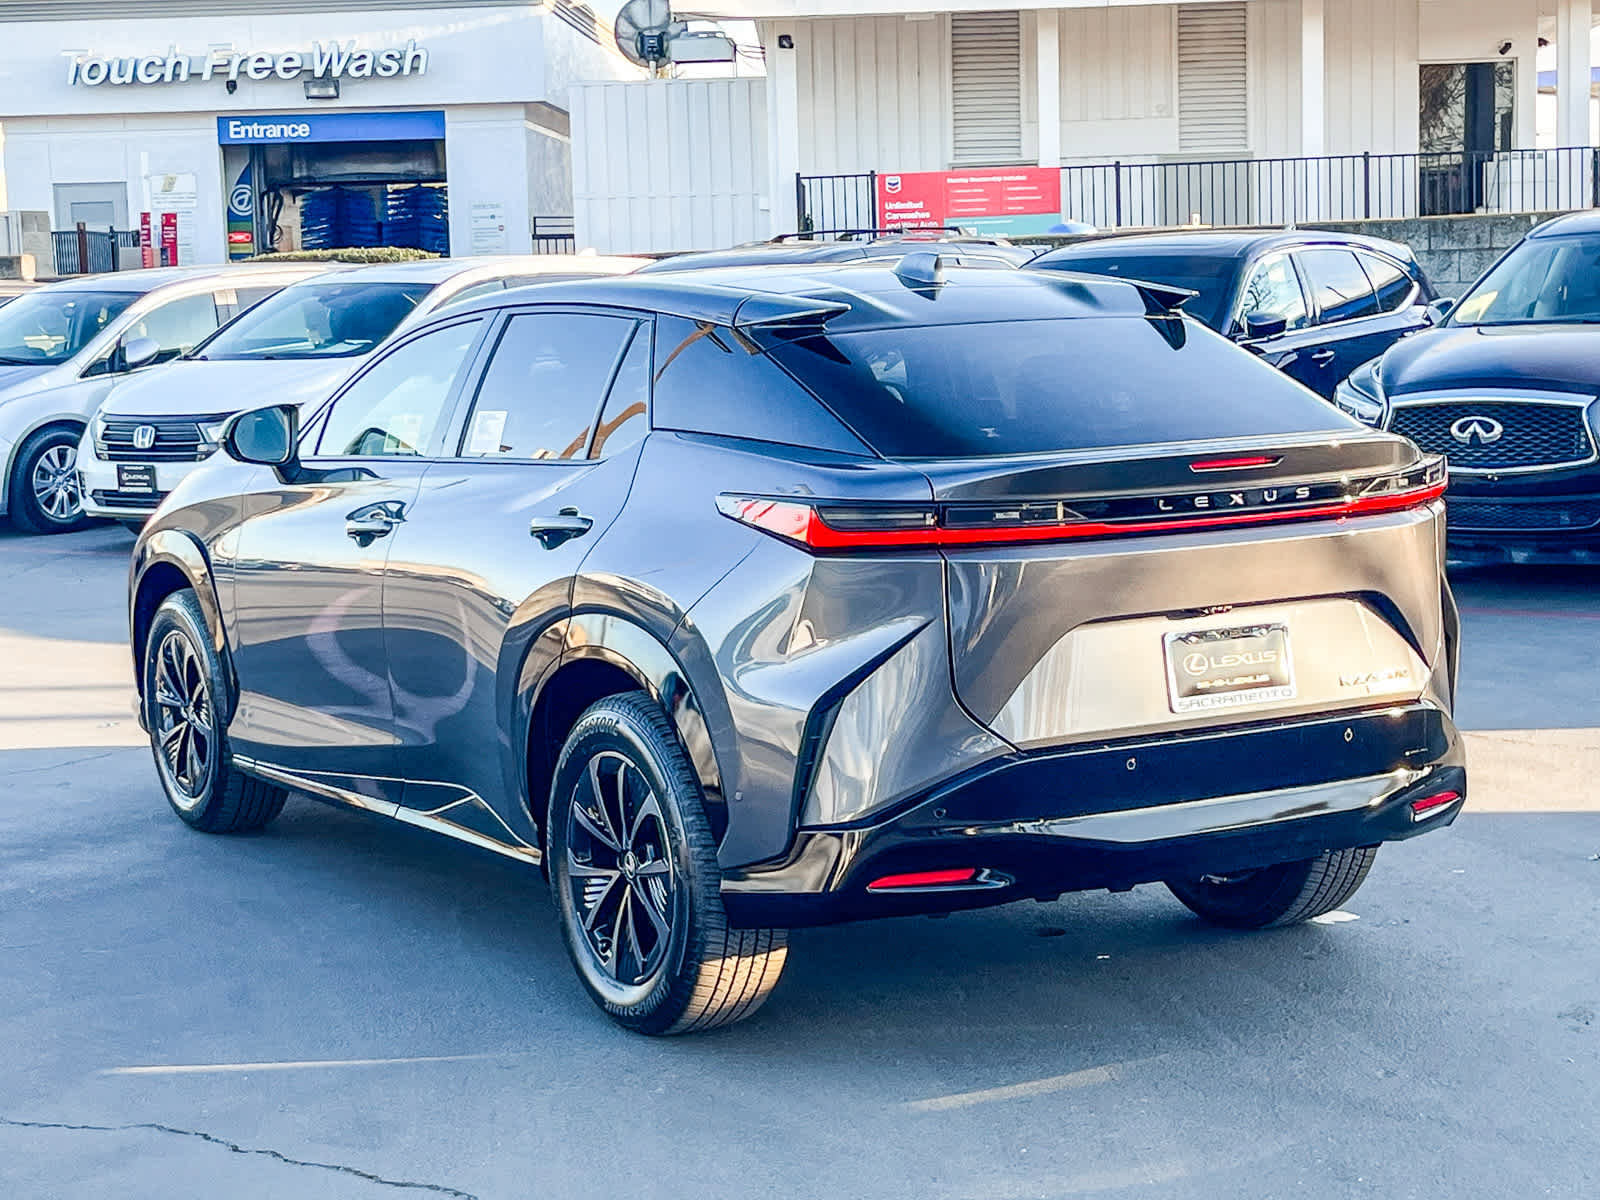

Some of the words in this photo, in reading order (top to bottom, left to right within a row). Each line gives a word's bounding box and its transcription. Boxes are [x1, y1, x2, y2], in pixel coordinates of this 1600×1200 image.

[61, 44, 192, 86] Touch
[202, 43, 303, 82] Free
[310, 39, 430, 79] Wash
[228, 120, 311, 139] Entrance
[885, 201, 924, 210] Unlimited
[1159, 487, 1310, 511] LEXUS
[1209, 649, 1280, 669] LEXUS
[1178, 687, 1293, 711] SACRAMENTO
